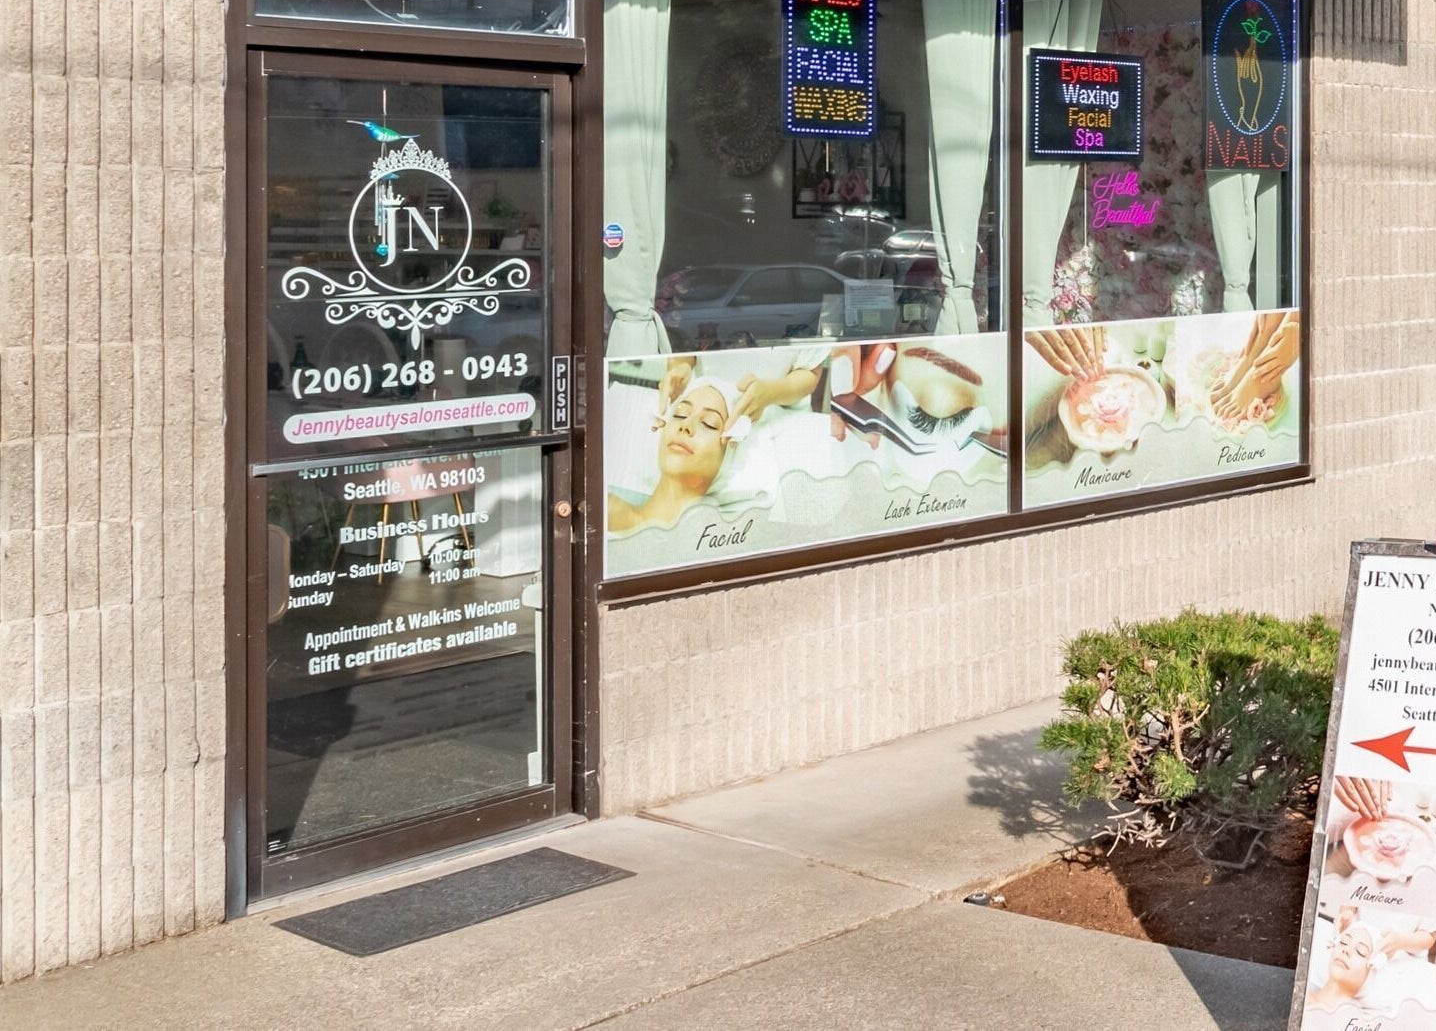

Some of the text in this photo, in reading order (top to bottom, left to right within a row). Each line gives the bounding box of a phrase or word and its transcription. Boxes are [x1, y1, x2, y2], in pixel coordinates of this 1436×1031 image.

[809, 9, 853, 45] SPA
[797, 46, 865, 84] FACIAL
[1061, 61, 1119, 85] Eyelash
[792, 85, 868, 122] WAXING
[1061, 84, 1120, 109] Waxing
[1068, 107, 1112, 129] Facial
[1074, 128, 1104, 150] Spa
[1206, 121, 1289, 169] NAILS
[1093, 170, 1140, 199] Hello
[1092, 199, 1161, 229] Beautiful
[380, 205, 445, 267] JN
[292, 364, 372, 399] (206)
[381, 359, 435, 389] 268
[462, 352, 529, 381] 0943
[556, 363, 567, 422] PUSH
[292, 399, 530, 437] Jennybeautysalonseattle.com
[1217, 444, 1267, 467] Pedicure
[343, 466, 486, 501] Seattle, WA 98103
[1074, 466, 1133, 490] Manicure
[884, 493, 968, 522] Lash Extension
[340, 510, 490, 544] Business Hours
[696, 519, 753, 552] Facial
[350, 559, 406, 579] Saturday
[428, 549, 460, 565] 10:00
[428, 568, 460, 584] 11:00
[1363, 570, 1431, 591] JENNY
[304, 596, 521, 652] Appointment & Walk-ins Welcome
[308, 620, 517, 676] Gift certificates available
[1367, 677, 1400, 695] 4501
[1349, 884, 1405, 907] Manicure
